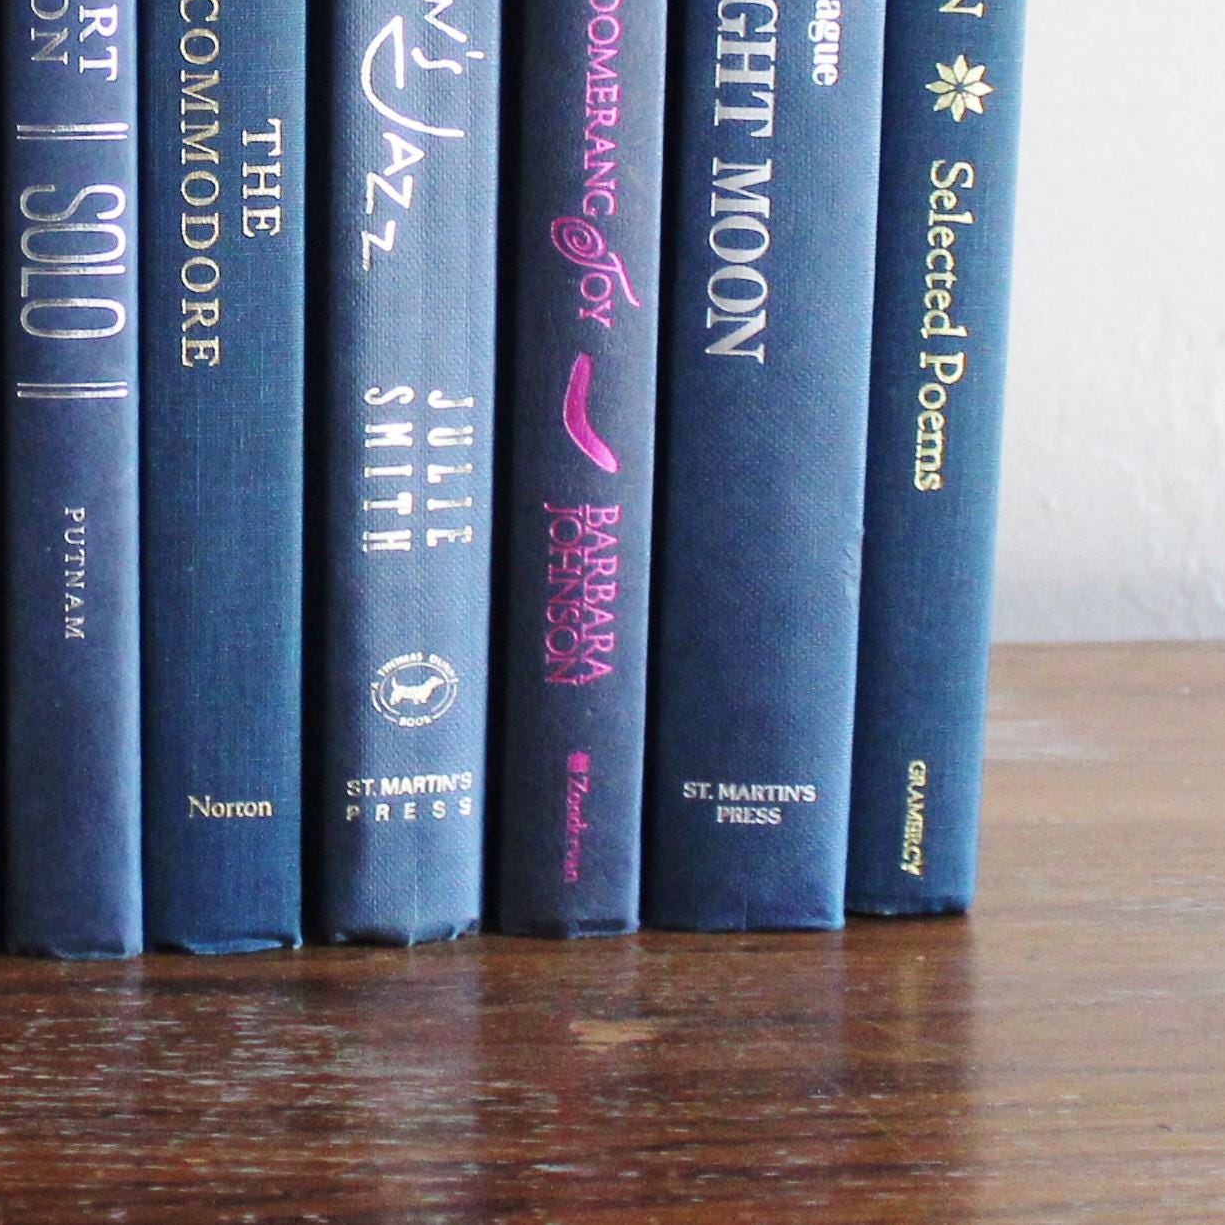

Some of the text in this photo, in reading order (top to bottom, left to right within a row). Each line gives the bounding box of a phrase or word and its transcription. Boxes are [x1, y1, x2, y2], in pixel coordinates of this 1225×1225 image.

[241, 117, 284, 239] THE
[359, 13, 467, 273] JAZZ
[19, 182, 128, 340] SOLO
[705, 157, 773, 365] MOON
[913, 159, 974, 492] Selected Poems
[362, 384, 416, 554] SMITH
[426, 387, 477, 546] JULIE
[63, 506, 87, 642] PUTNAM
[544, 501, 583, 687] JOHNSON
[576, 502, 622, 685] BARBARA
[187, 794, 274, 820] Norton
[345, 796, 473, 823] PRESS
[346, 770, 473, 797] ST. MARTIN'S
[682, 782, 817, 804] ST. MARTIN'S
[715, 804, 782, 824] PRESS
